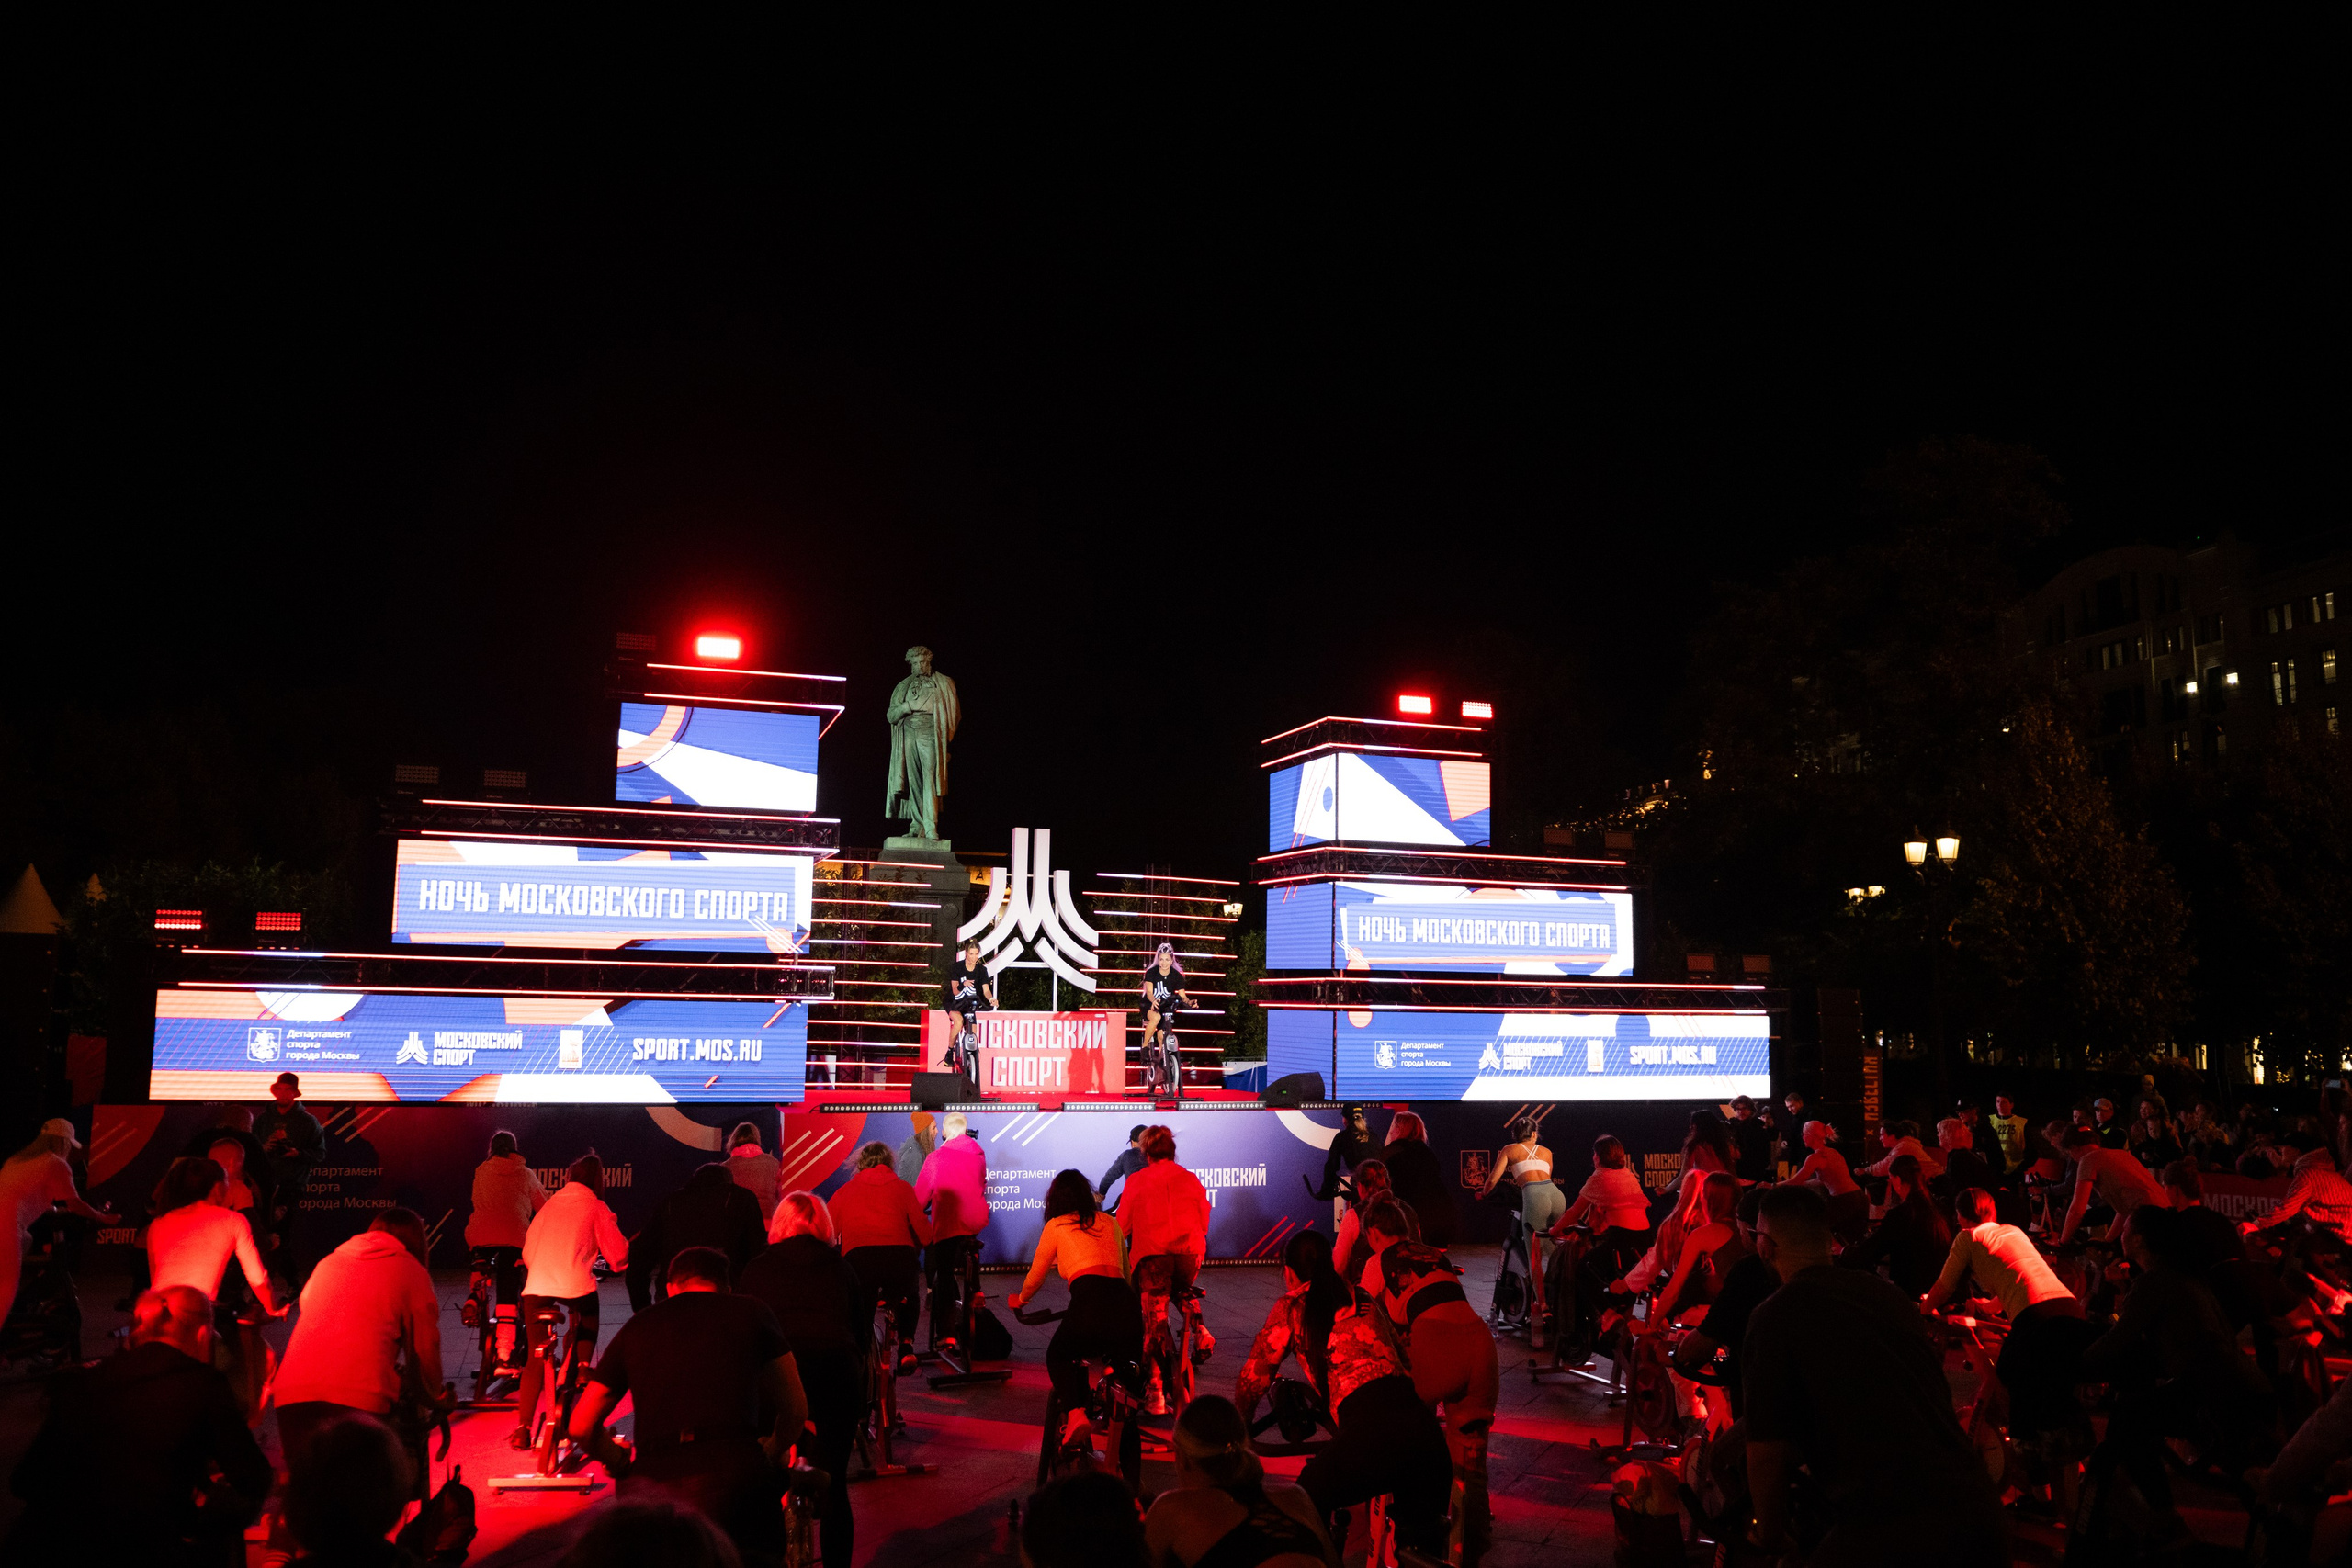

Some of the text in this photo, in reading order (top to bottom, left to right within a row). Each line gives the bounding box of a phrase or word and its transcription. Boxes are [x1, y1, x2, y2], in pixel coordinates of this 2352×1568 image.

[419, 879, 788, 922] НОЧЬ МОСКОВСКОГО СПОРТА
[1358, 916, 1611, 949] НОЧЬ МОСКОВСКОГО СПОРТА
[286, 1029, 352, 1040] Департамент
[960, 1013, 1107, 1049] ОСКОВСКИЙ
[286, 1041, 321, 1050] спорта
[434, 1030, 523, 1049] МОСКОВСКИЙ
[1400, 1041, 1445, 1051] Департамент
[286, 1051, 360, 1061] города Москвы
[632, 1037, 763, 1062] SPORT.MOS.RU
[1400, 1051, 1424, 1060] спорта
[1629, 1045, 1717, 1065] SPORT.MOS.RU
[433, 1049, 477, 1066] СПОРТ
[1400, 1058, 1451, 1069] города Москвы
[992, 1056, 1066, 1087] СПОРТ
[1997, 1124, 2016, 1135] 2275
[1645, 1153, 1683, 1169] МОСКО
[1187, 1163, 1267, 1188] СКОВСКИЙ
[984, 1184, 1021, 1196] порта
[299, 1196, 397, 1211] орода Москвы
[986, 1201, 1021, 1212] орода
